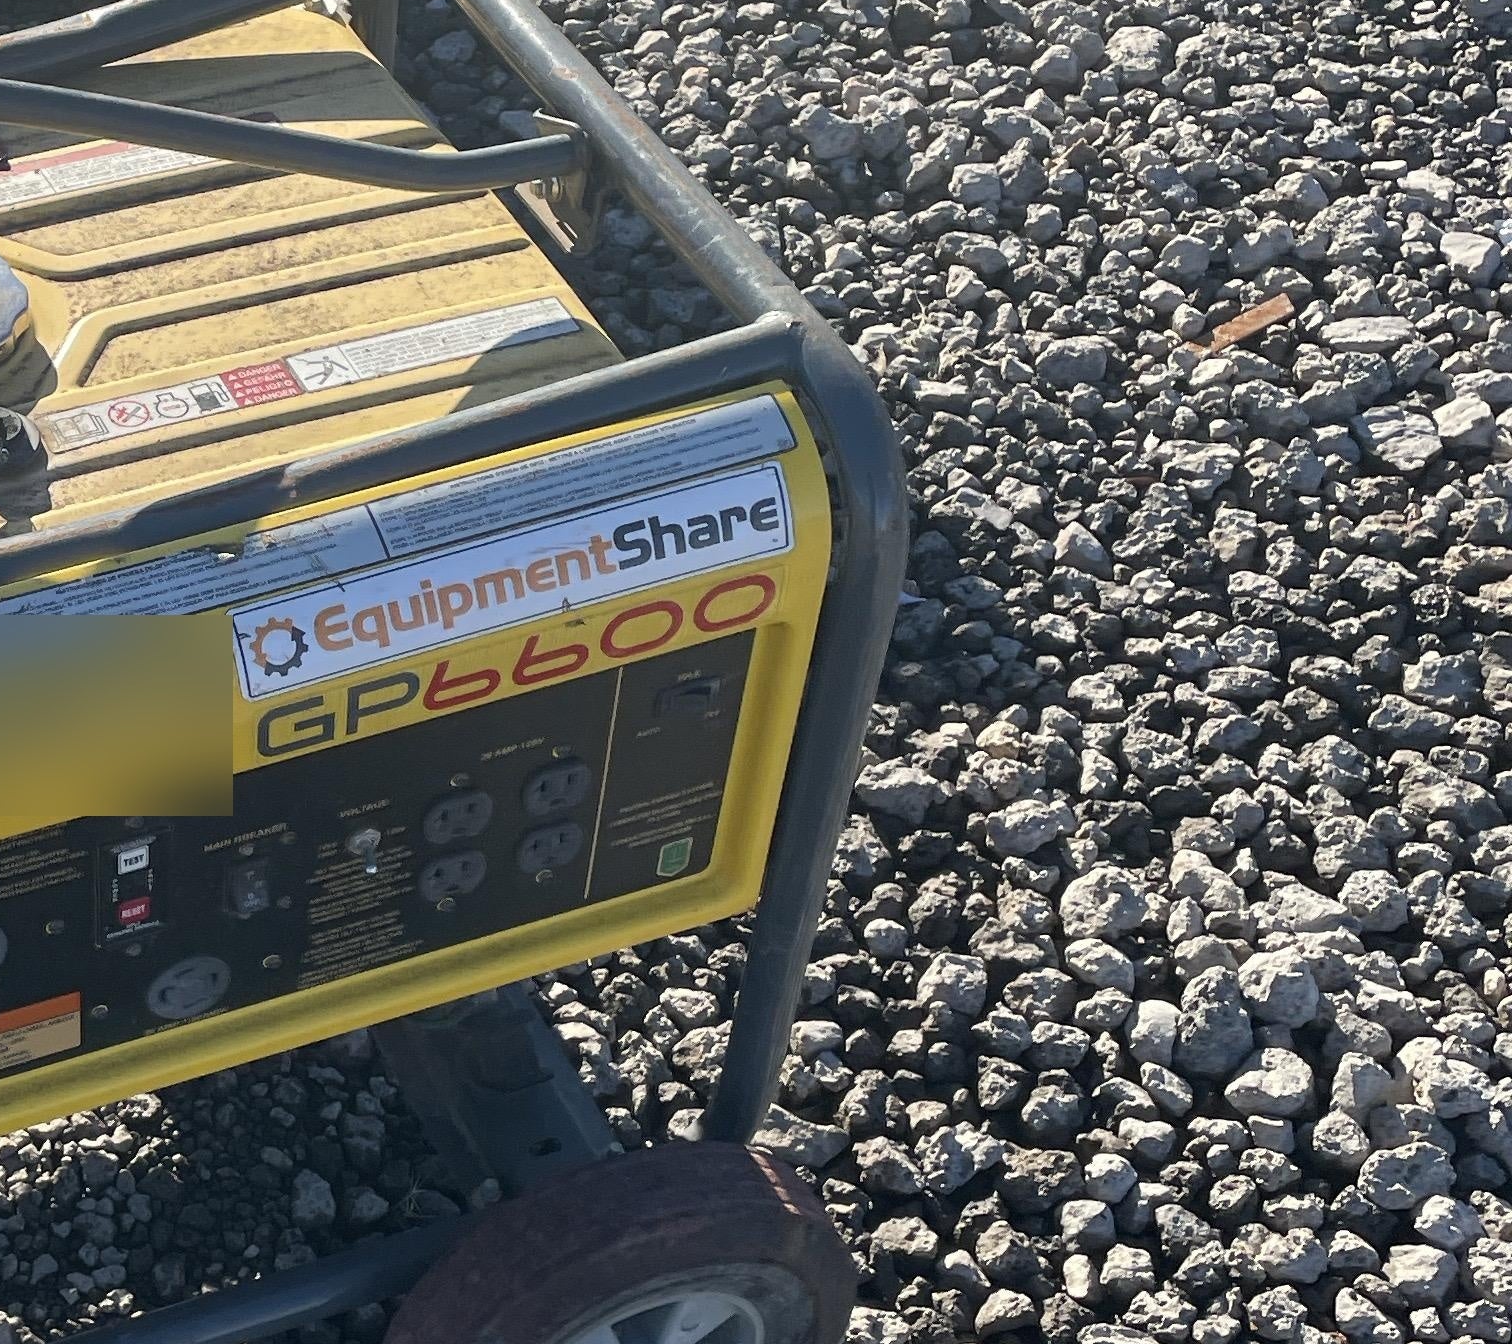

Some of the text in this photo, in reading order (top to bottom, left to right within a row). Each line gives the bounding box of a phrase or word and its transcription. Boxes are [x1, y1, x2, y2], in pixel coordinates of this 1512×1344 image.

[237, 363, 281, 378] DANGER
[313, 496, 779, 649] EquipmentShare
[256, 572, 777, 759] GP6600
[123, 853, 145, 867] TEST
